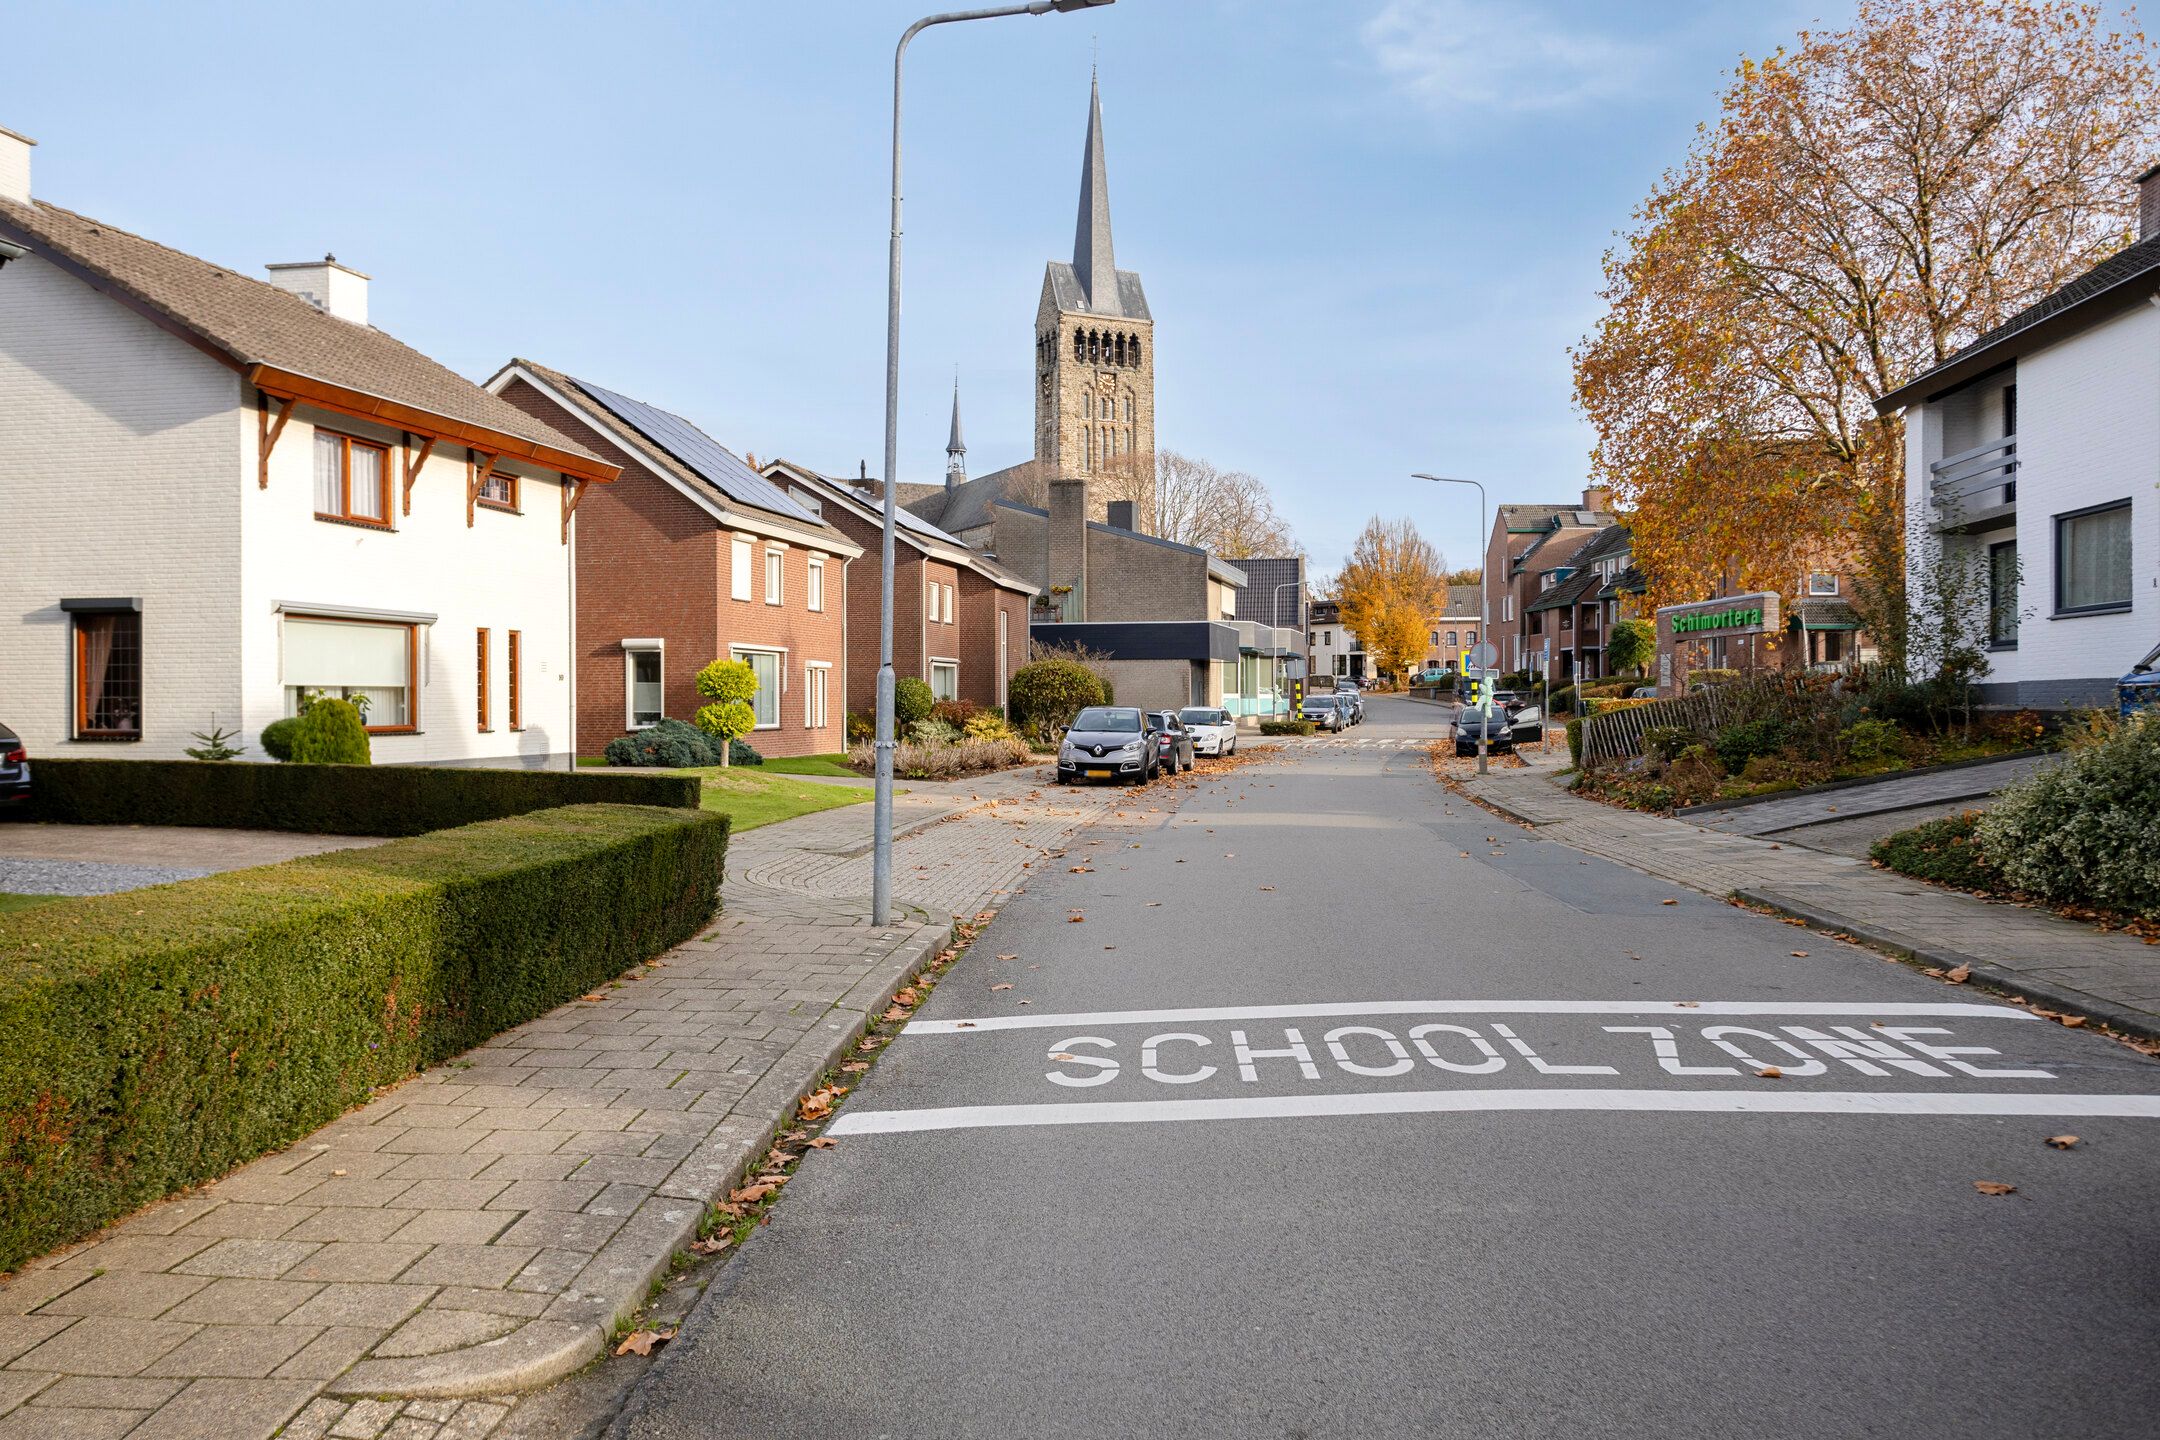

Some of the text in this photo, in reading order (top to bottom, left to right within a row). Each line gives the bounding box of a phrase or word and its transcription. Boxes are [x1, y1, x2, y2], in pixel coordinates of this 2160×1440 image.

[1671, 608, 1762, 633] Schimortera
[1045, 1023, 2059, 1088] SCHOOL ZONE
